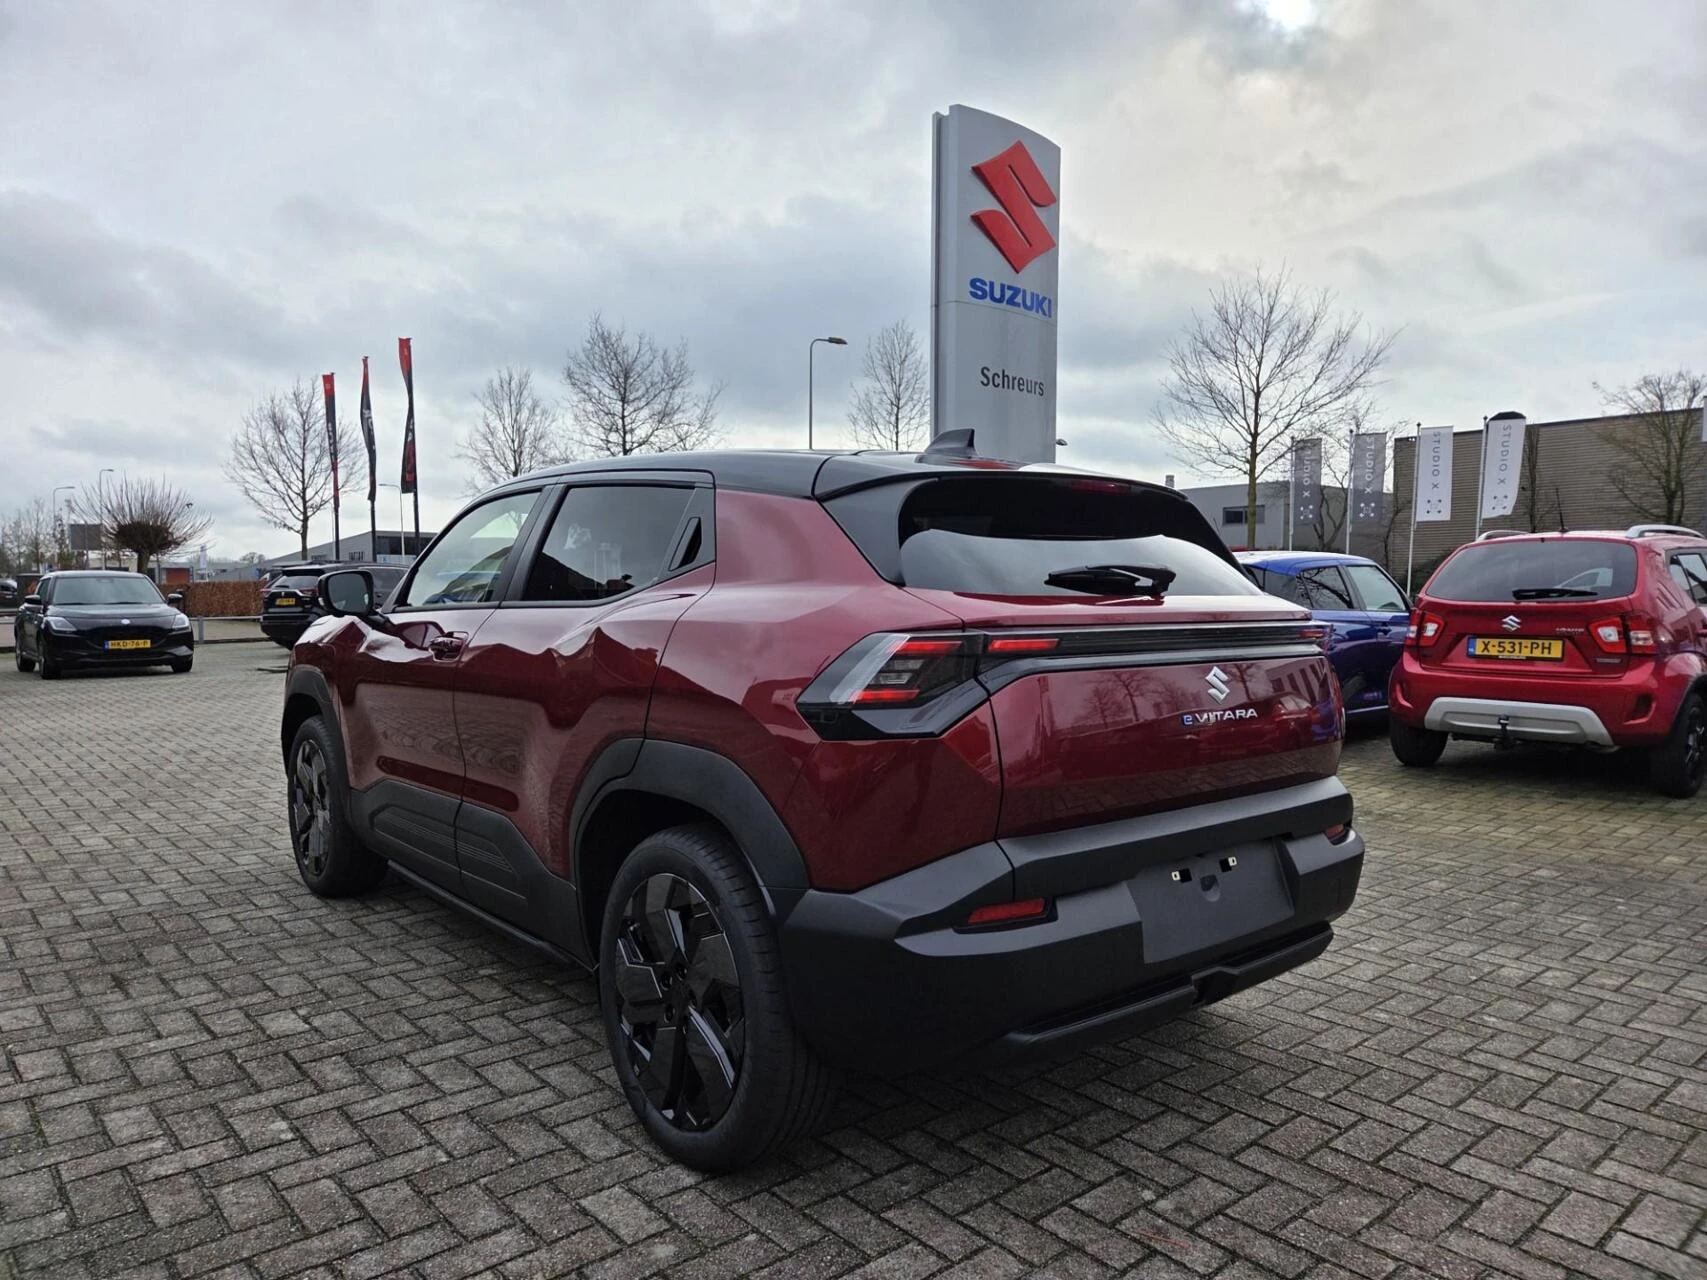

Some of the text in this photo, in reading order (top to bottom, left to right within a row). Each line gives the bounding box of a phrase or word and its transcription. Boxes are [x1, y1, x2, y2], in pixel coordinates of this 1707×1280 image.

[969, 277, 1052, 318] SUZUKI
[980, 366, 1045, 396] Schreurs
[1365, 437, 1374, 481] STUDIO
[1432, 431, 1441, 477] STUDIO
[1499, 424, 1511, 472] STUDIO
[1481, 640, 1552, 655] X-531-PH
